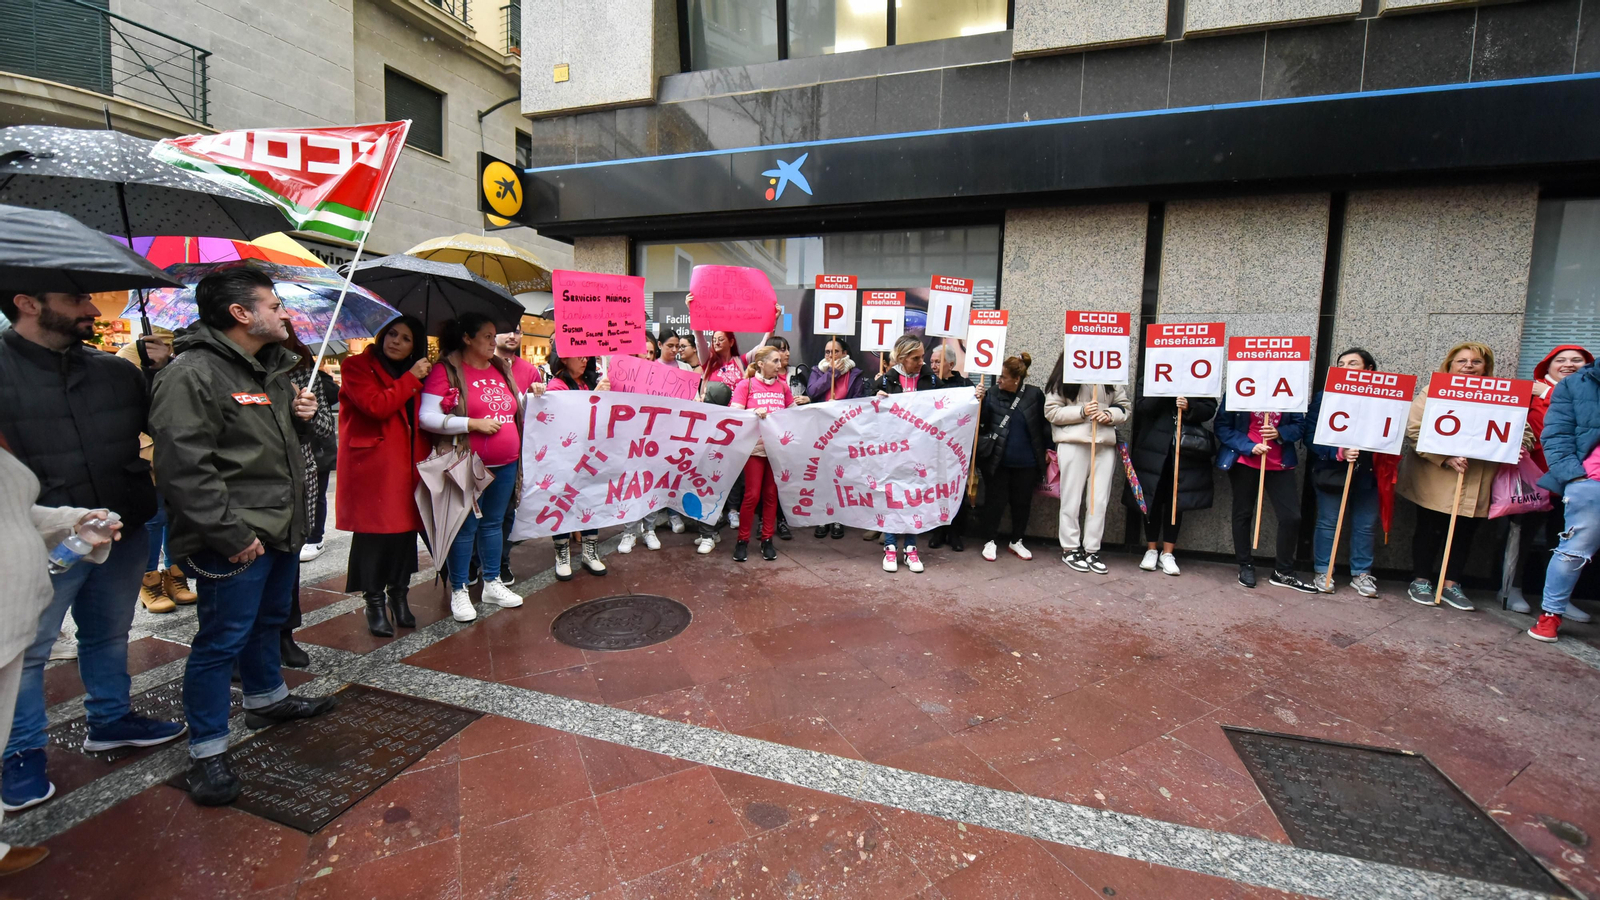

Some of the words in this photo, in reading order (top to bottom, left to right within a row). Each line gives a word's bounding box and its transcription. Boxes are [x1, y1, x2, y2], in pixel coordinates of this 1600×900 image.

[617, 278, 629, 291] de
[934, 284, 968, 293] enseñanza
[940, 277, 965, 286] CCOO
[824, 303, 844, 329] P
[943, 305, 953, 331] I
[1079, 313, 1118, 324] CCOO
[871, 319, 892, 345] T
[1072, 324, 1124, 334] enseñanza
[1162, 325, 1209, 336] CCOO
[1154, 336, 1216, 346] enseñanza
[1245, 338, 1293, 349] CCOO
[974, 339, 994, 367] S
[1073, 350, 1122, 370] SUB
[1236, 349, 1301, 359] enseñanza
[1154, 364, 1173, 382] R
[1190, 359, 1212, 379] O
[1345, 370, 1398, 386] CCOO
[1235, 377, 1256, 397] G
[1271, 378, 1294, 397] A
[1334, 382, 1404, 398] enseñanza
[1451, 375, 1511, 392] CCOO
[1438, 388, 1519, 404] enseñanza
[871, 399, 881, 413] Y
[889, 402, 947, 440] DERECHOS
[1328, 411, 1350, 432] C
[1382, 417, 1392, 438] I
[1434, 410, 1461, 436] Ó
[1485, 420, 1511, 443] N
[628, 437, 659, 459] NO
[664, 447, 714, 497] SOMOS
[803, 457, 820, 480] UNA
[605, 471, 683, 505] NADA!
[792, 487, 815, 516] POR
